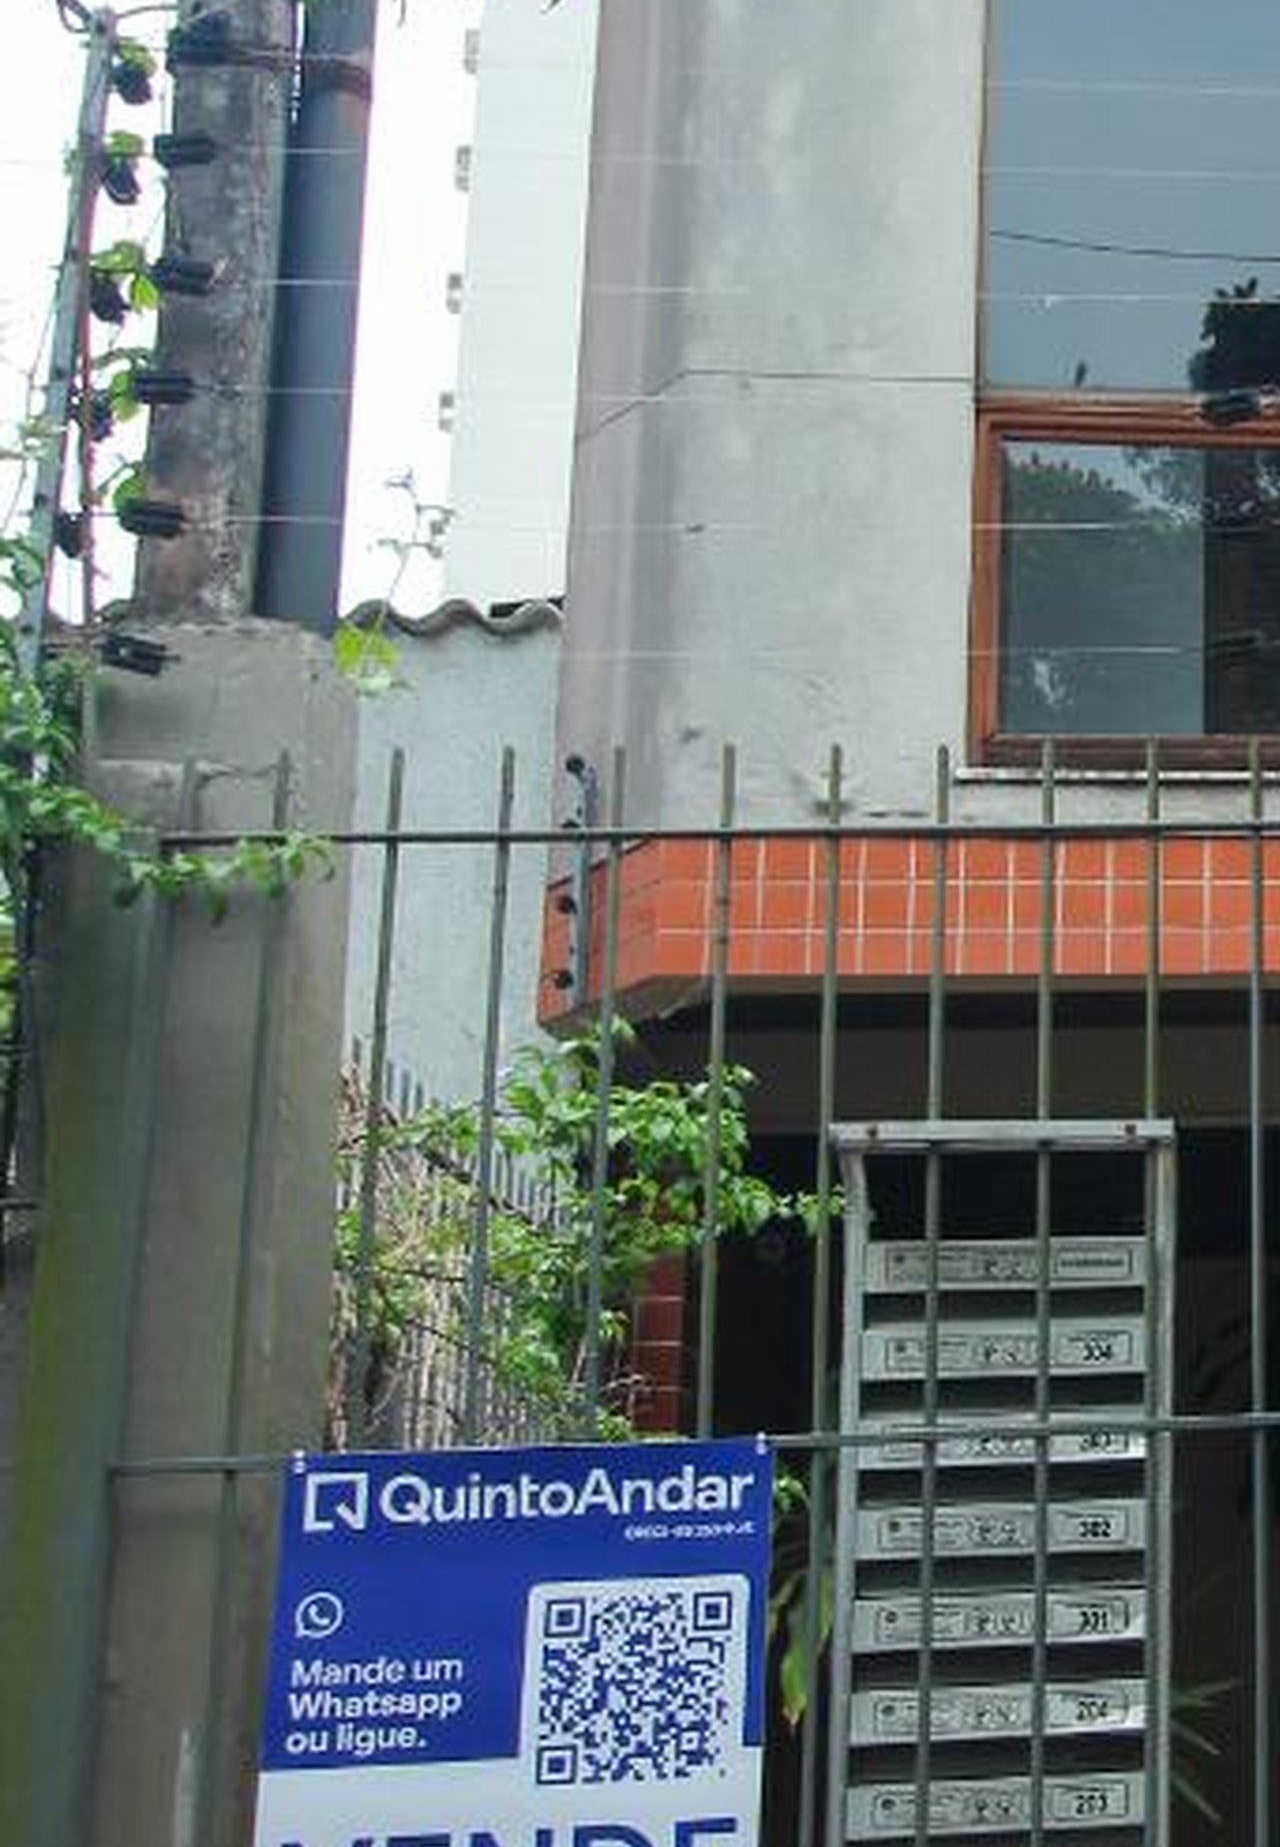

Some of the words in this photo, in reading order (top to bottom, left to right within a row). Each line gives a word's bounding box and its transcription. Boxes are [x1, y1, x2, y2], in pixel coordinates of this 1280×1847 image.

[379, 1464, 755, 1526] QuintoAndar
[291, 1660, 406, 1688] Mande
[411, 1659, 464, 1681] um
[288, 1690, 462, 1721] Whatsapp
[286, 1730, 329, 1754] ou
[336, 1721, 427, 1756] ligue.
